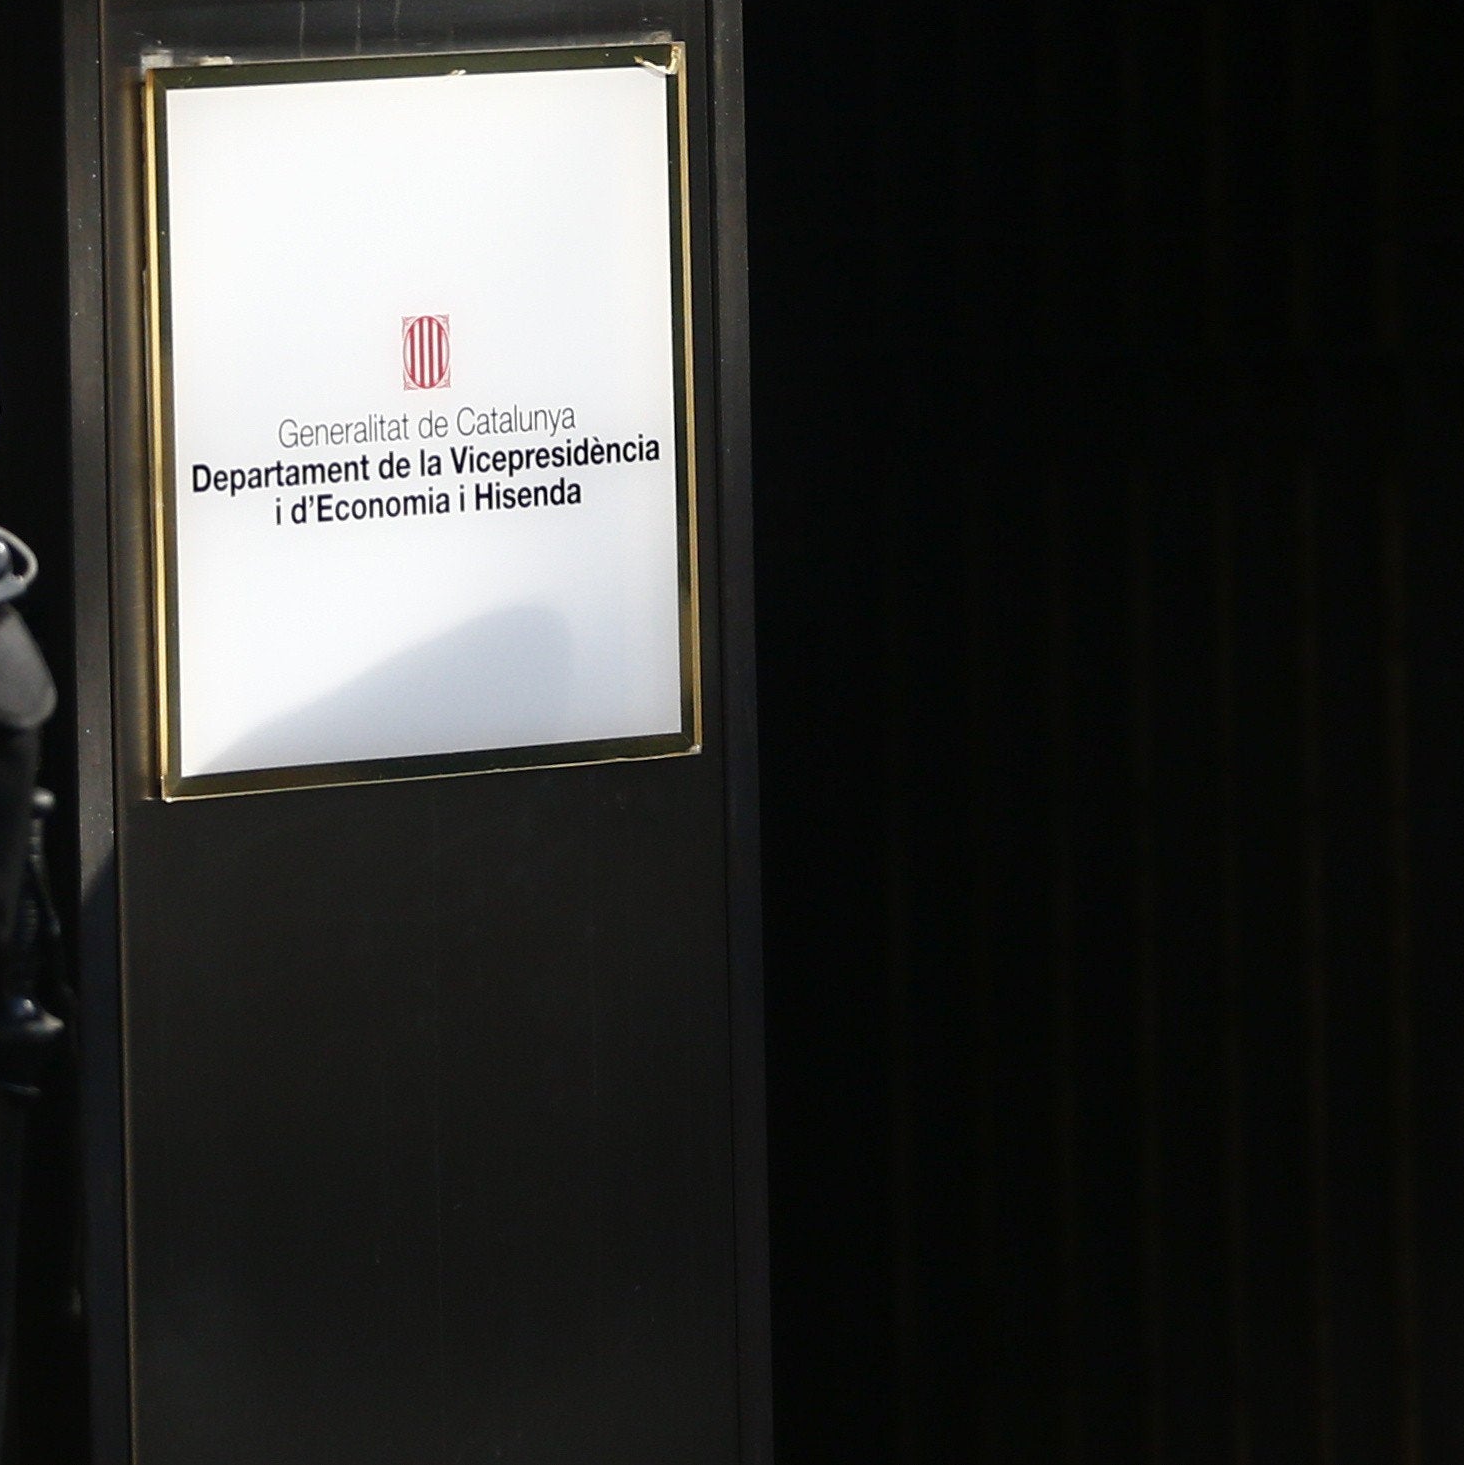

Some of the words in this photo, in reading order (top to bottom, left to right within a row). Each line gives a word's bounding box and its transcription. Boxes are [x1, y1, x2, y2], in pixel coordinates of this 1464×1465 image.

[278, 413, 410, 449] Generalitat
[418, 410, 449, 439] de
[456, 404, 576, 437] Catalunya
[192, 454, 370, 498] Departament
[378, 450, 412, 480] de
[420, 447, 443, 478] la
[449, 436, 661, 478] Vicepresidència
[276, 498, 282, 526] i
[459, 485, 466, 513] i
[474, 476, 582, 512] Hisenda
